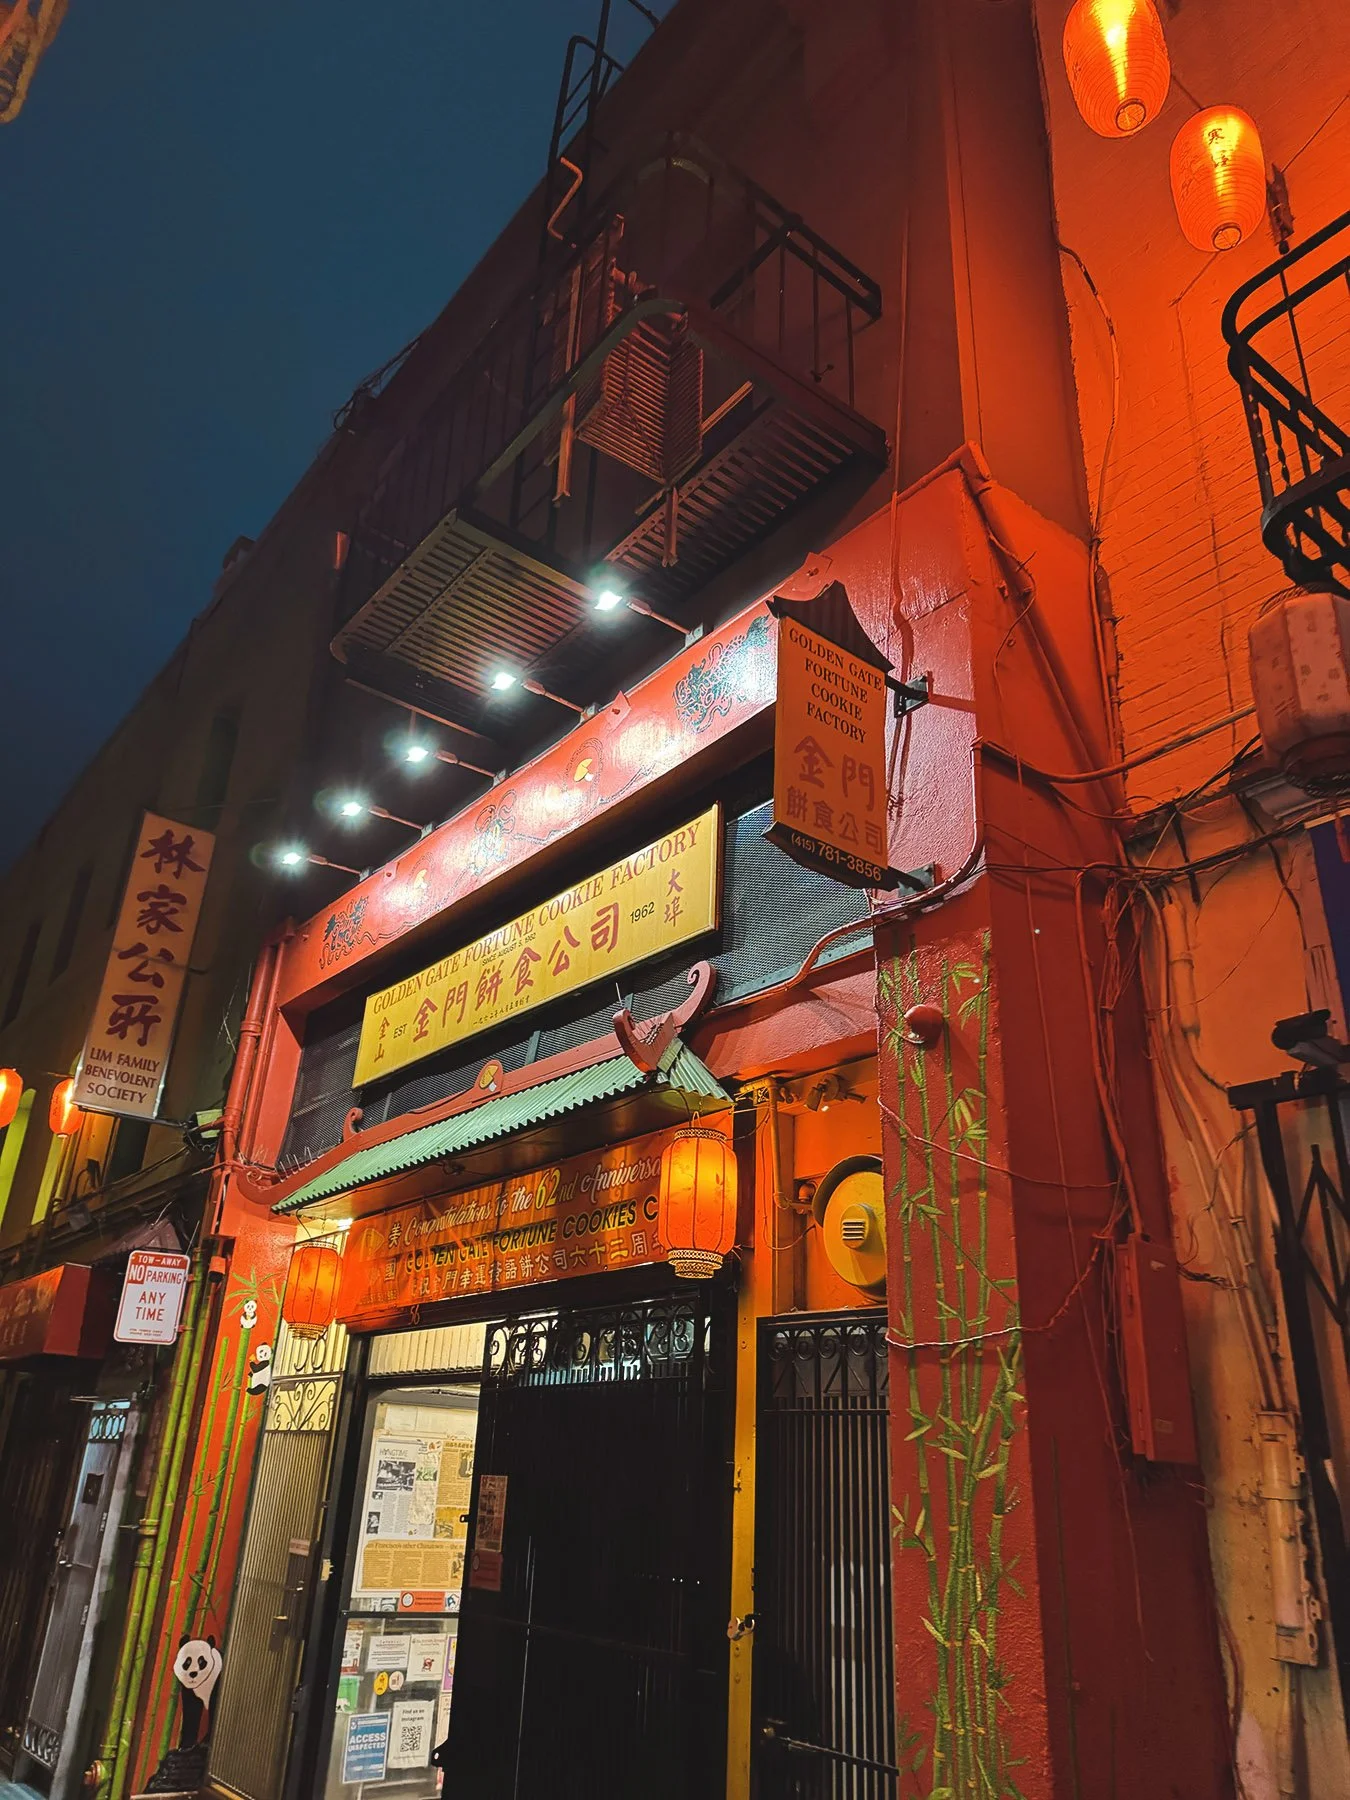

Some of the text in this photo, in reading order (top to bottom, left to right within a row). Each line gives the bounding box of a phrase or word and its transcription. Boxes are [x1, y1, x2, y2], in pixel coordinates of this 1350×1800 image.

[789, 627, 882, 691] GOLDEN GATE
[805, 657, 868, 704] FORTUNE
[811, 683, 863, 721] COOKIE
[807, 701, 867, 744] FACTORY
[793, 735, 875, 812] 金門
[791, 832, 882, 882] (415) 781-3856
[373, 821, 702, 1015] GOLDEN GATE FORTUNE COOKIE FACTORY
[629, 901, 656, 924] 1962
[412, 902, 620, 1043] 金門餅食公司
[393, 1021, 407, 1040] EST
[90, 1047, 160, 1073] LIM FAMILY
[85, 1064, 158, 1089] BENEVOLENT
[86, 1081, 148, 1105] SOCIETY
[510, 1184, 534, 1214] the
[580, 1155, 661, 1204] Anniversa
[405, 1240, 457, 1275] GOLDEN
[458, 1232, 490, 1264] GATE
[491, 1218, 558, 1254] FORTUNE
[562, 1199, 638, 1241] COOKIES
[138, 1254, 182, 1267] TOW-AWAY
[129, 1264, 182, 1285] NO PARKING
[138, 1290, 167, 1305] ANY
[135, 1306, 165, 1322] TIME
[347, 1742, 387, 1752] INSPECTED
[348, 1732, 387, 1745] ACCESS
